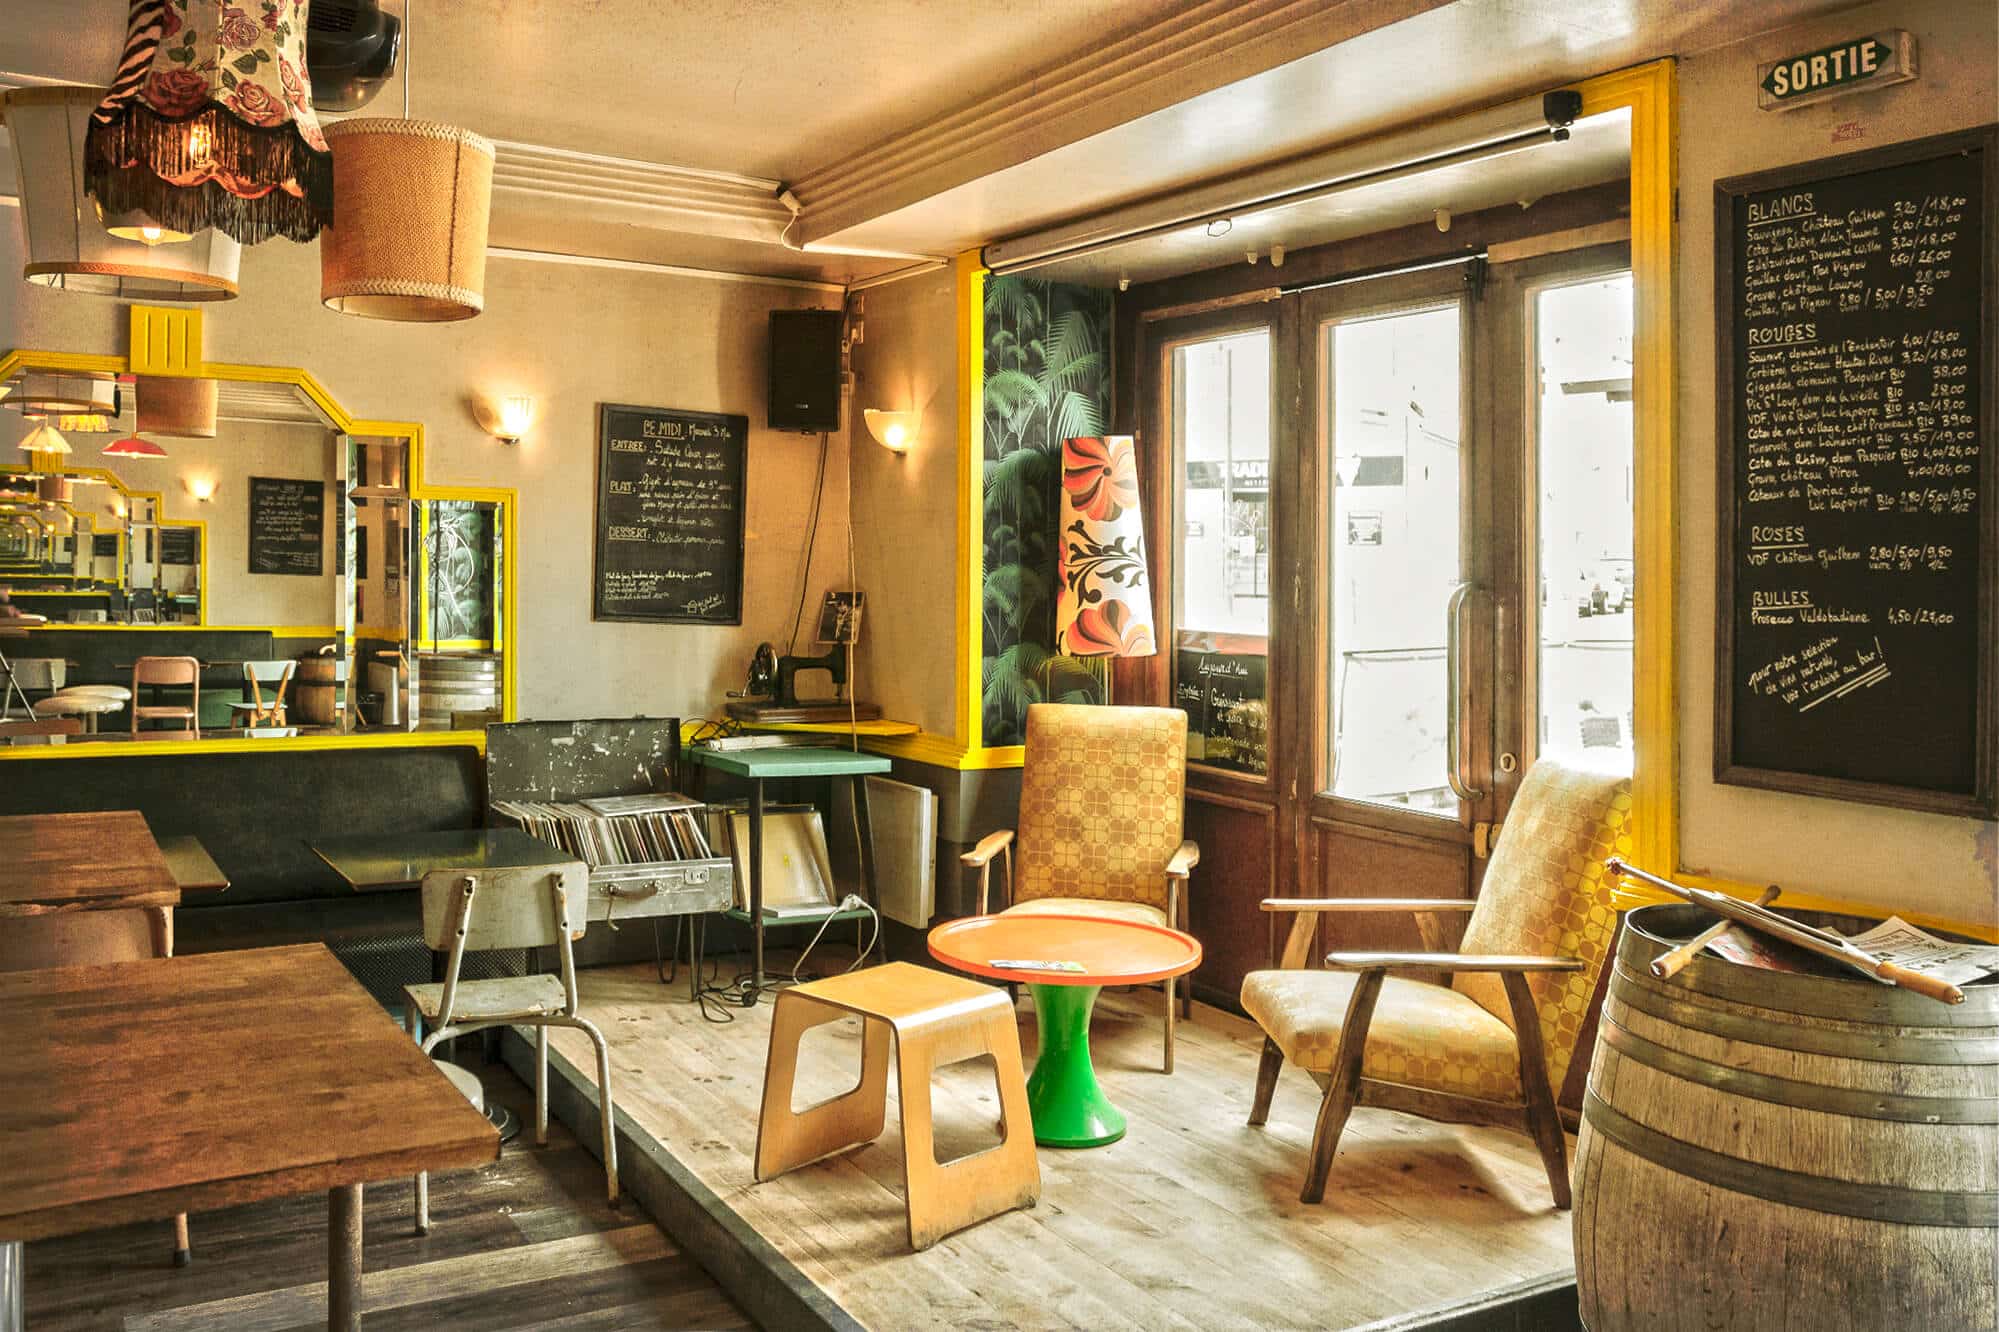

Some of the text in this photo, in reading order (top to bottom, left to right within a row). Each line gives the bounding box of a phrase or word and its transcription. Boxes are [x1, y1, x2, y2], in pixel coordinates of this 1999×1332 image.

[1774, 41, 1877, 96] SORTIE
[1748, 193, 1815, 221] BLANCS
[1810, 249, 1851, 261] Domaine
[1749, 323, 1816, 345] ROUGES
[1887, 386, 1904, 399] BIO
[643, 419, 658, 435] CE
[1917, 416, 1935, 429] BIO
[1900, 447, 1919, 461] BIO
[1808, 497, 1825, 511] Luc
[1876, 493, 1895, 506] BIO
[1751, 525, 1805, 543] ROSES
[1747, 552, 1769, 566] VDF
[1753, 591, 1810, 606] BULLES
[1751, 610, 1794, 624] Prosecco
[1748, 664, 1772, 694] pour
[1765, 680, 1778, 695] de
